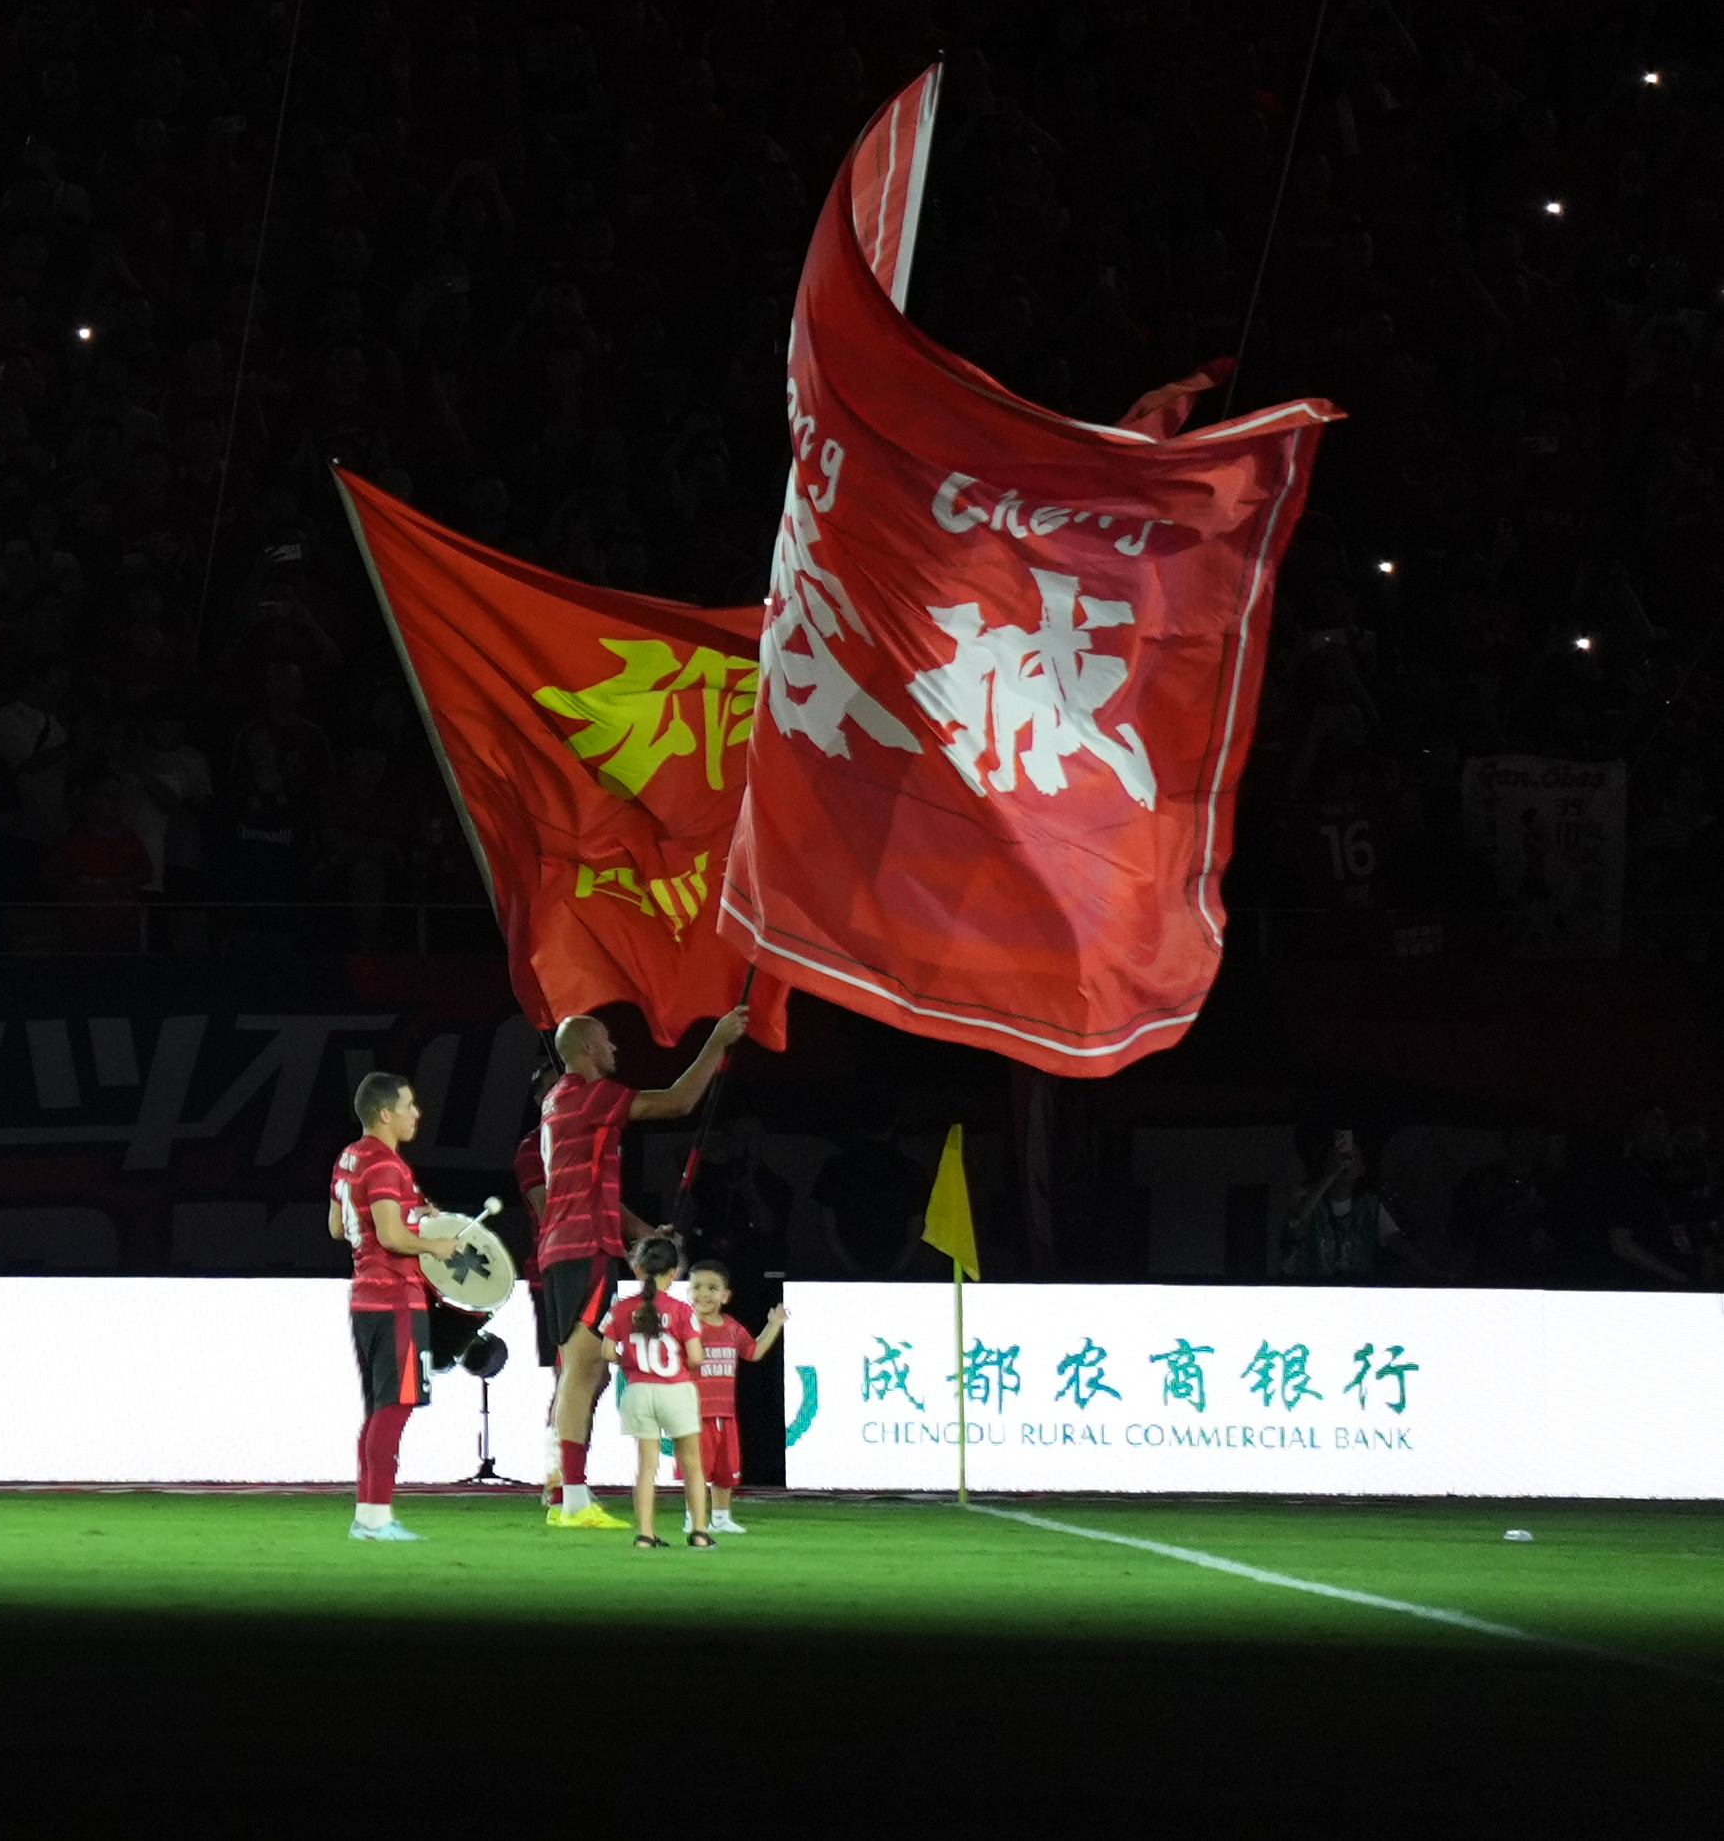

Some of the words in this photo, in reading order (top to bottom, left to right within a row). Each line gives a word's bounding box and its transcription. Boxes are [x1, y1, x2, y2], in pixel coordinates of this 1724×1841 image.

[1320, 819, 1376, 881] 16
[629, 1331, 681, 1378] 10
[861, 1336, 1421, 1414] 成都农商银行
[1020, 1423, 1112, 1446] RURAL
[1125, 1424, 1321, 1448] COMMERCIAL
[1334, 1426, 1414, 1450] BANK
